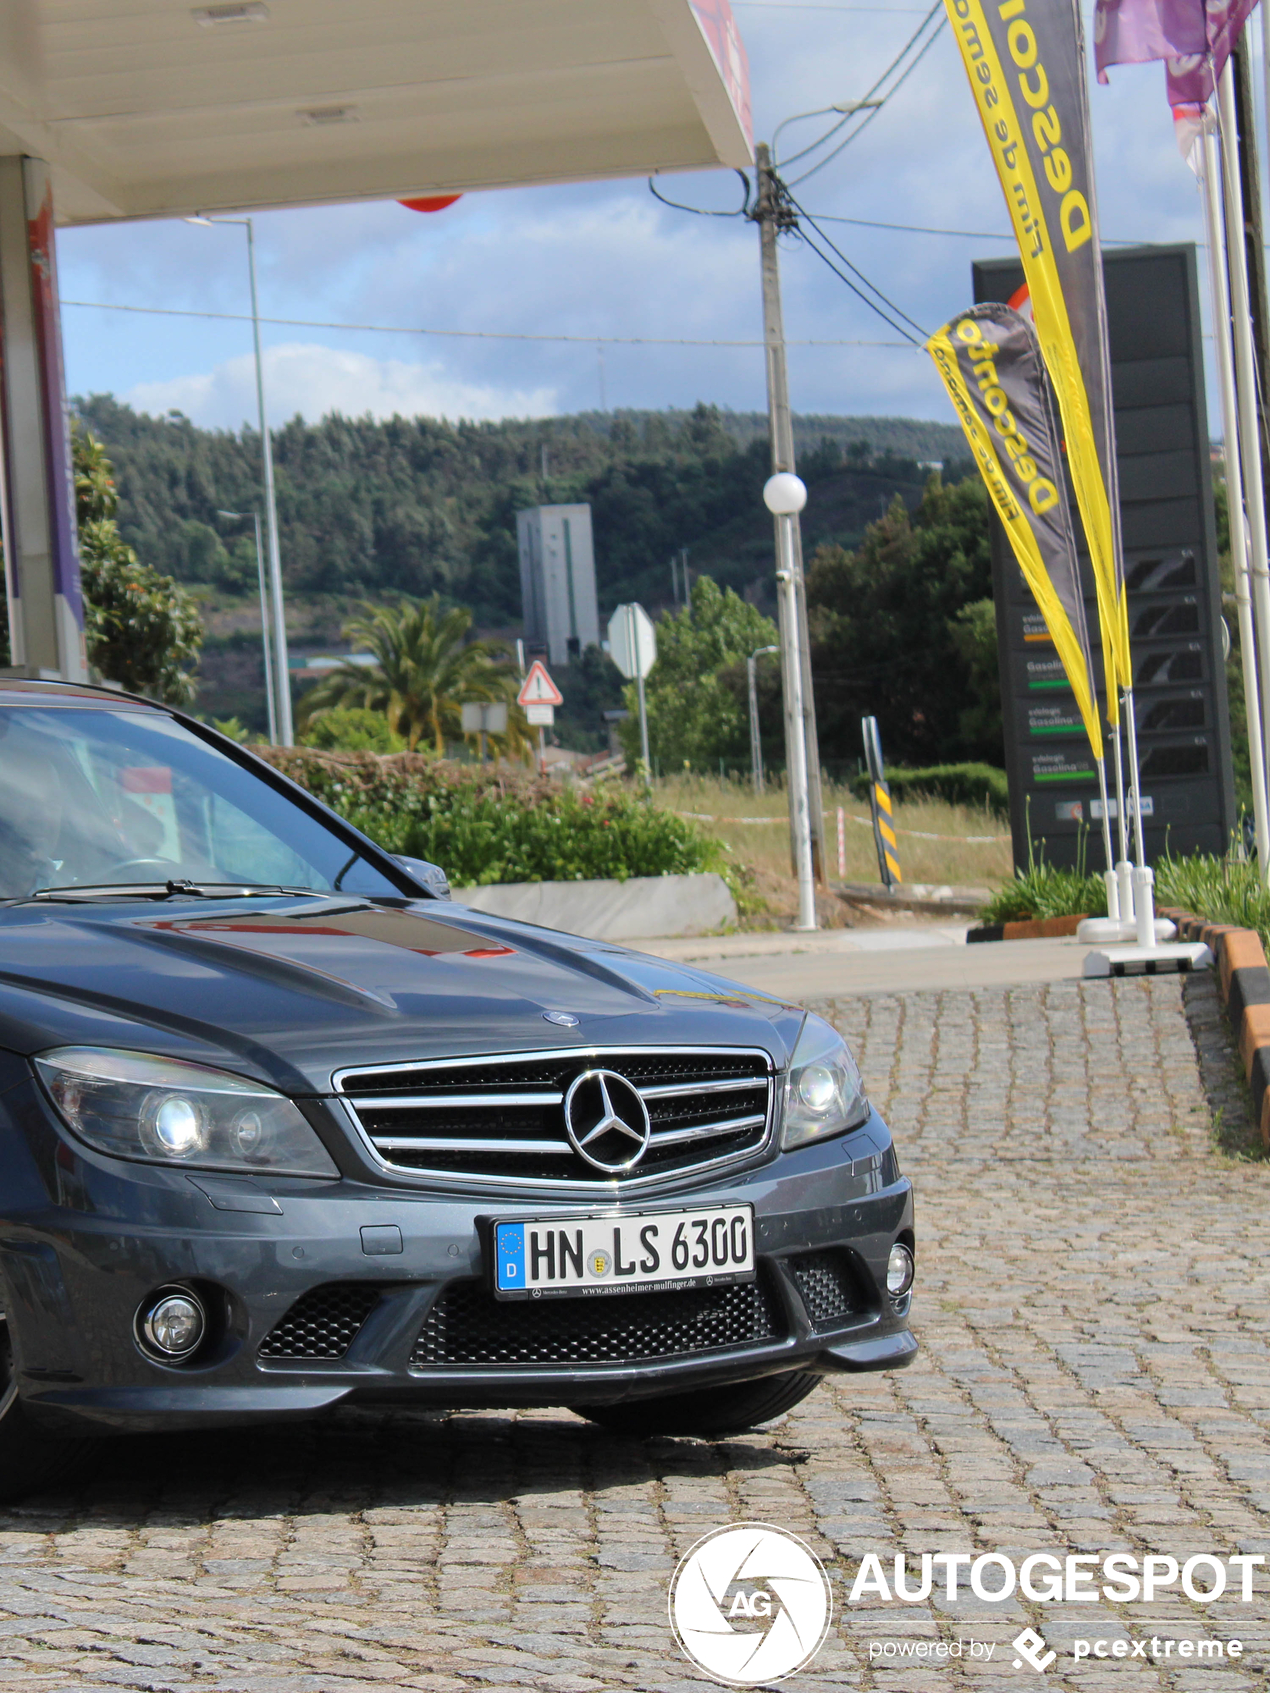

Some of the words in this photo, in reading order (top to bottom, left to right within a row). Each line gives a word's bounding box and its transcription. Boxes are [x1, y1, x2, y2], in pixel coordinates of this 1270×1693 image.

[506, 1262, 517, 1278] D
[530, 1229, 584, 1280] HN
[613, 1224, 660, 1276] LS
[671, 1215, 747, 1271] 6300
[582, 1278, 697, 1295] www.assenheimer-mulfinger.de
